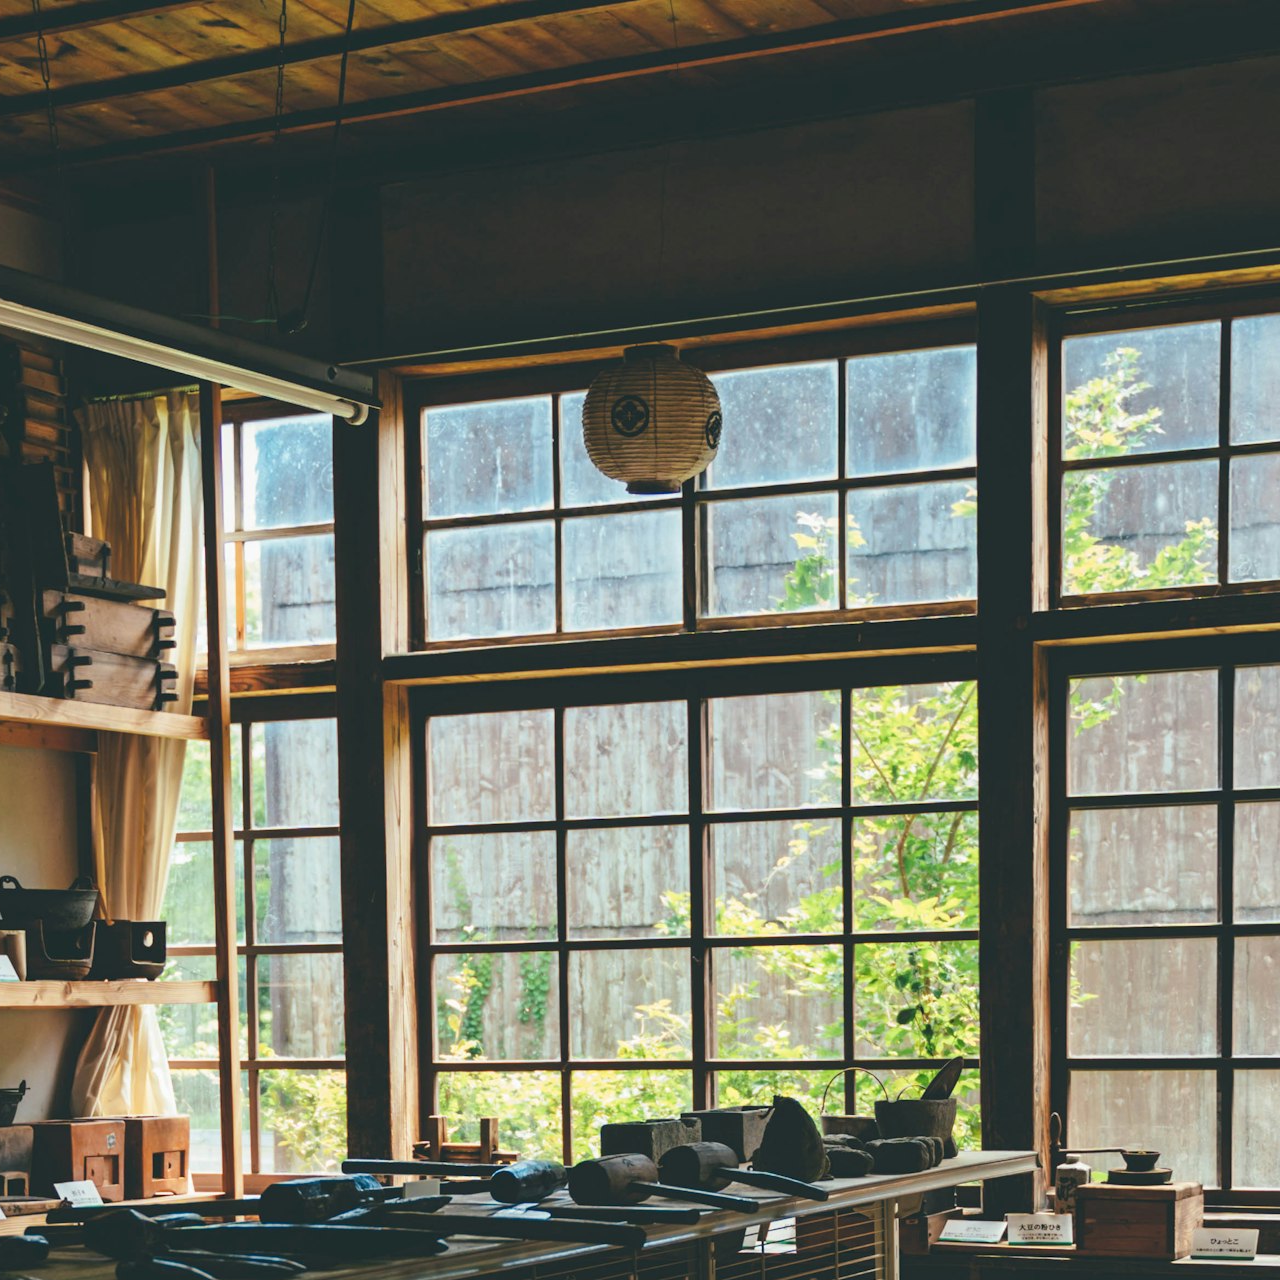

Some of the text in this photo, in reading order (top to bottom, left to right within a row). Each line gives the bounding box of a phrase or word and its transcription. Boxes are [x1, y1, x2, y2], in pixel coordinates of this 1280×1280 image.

[1018, 1223, 1062, 1232] 大豆の粉ひき
[1210, 1237, 1240, 1245] ひょっとこ
